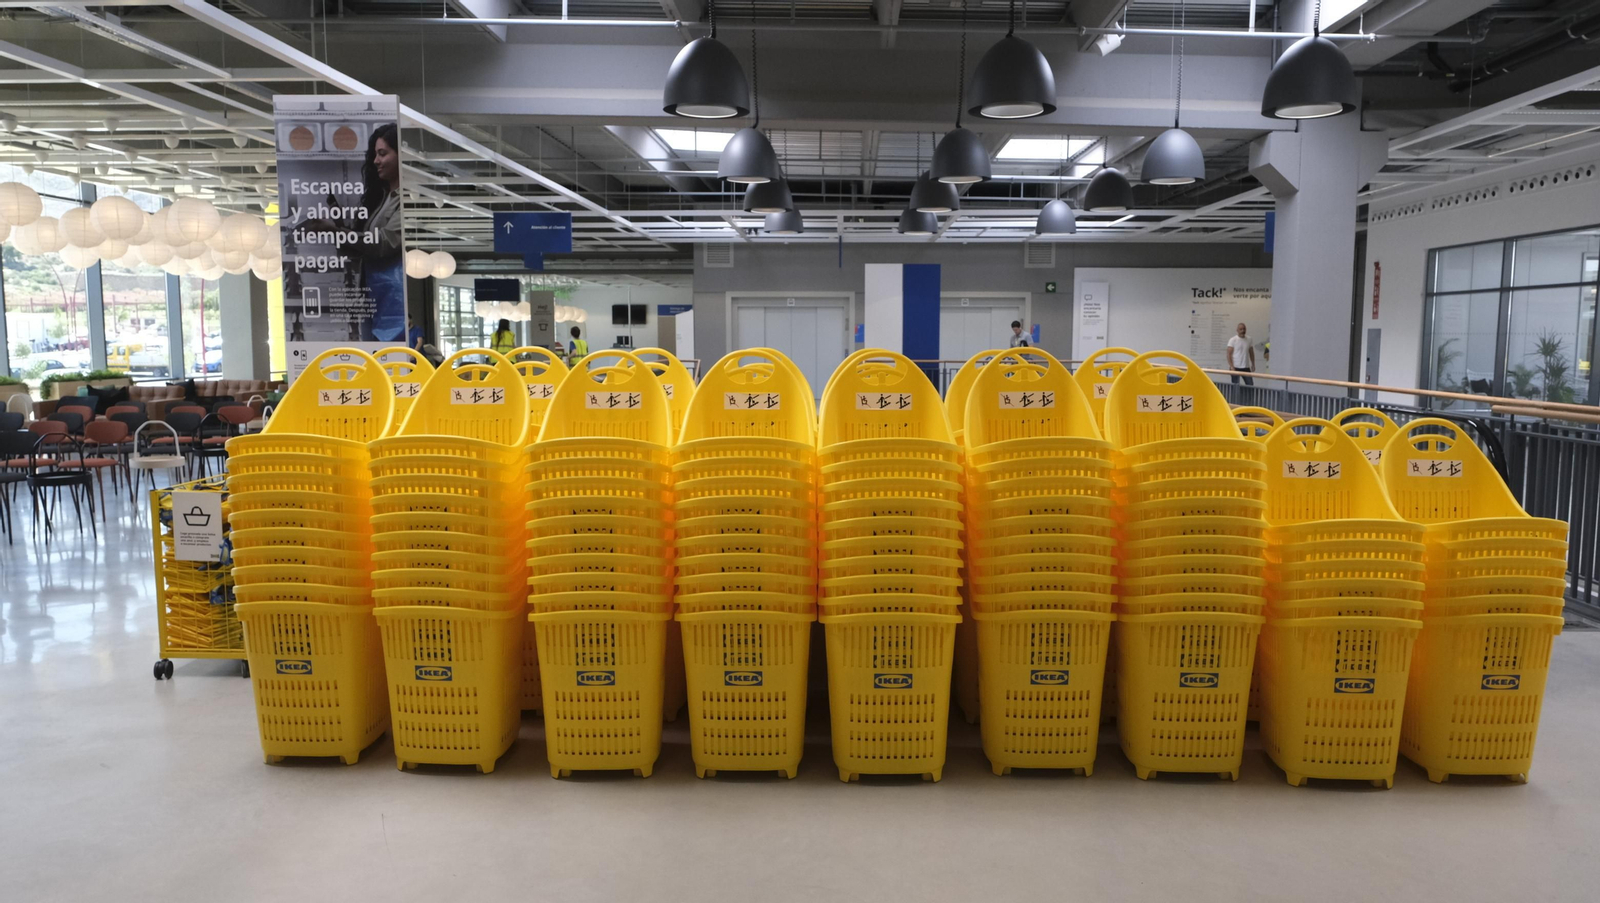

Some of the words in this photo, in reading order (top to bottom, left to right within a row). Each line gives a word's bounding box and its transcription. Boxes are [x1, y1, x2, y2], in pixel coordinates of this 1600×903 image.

[290, 178, 364, 196] Escanea
[291, 206, 302, 224] y
[306, 203, 368, 220] ahorra
[292, 228, 358, 249] tiempo
[363, 226, 380, 244] al
[294, 254, 348, 274] pagar
[279, 663, 310, 671] IKEA
[419, 669, 450, 677] IKEA
[580, 674, 613, 682] IKEA
[728, 674, 761, 682] IKEA
[877, 677, 910, 685] IKEA
[1034, 673, 1066, 682] IKEA
[1183, 676, 1216, 684] IKEA
[1338, 681, 1372, 690] IKEA
[1485, 678, 1518, 686] IKEA
